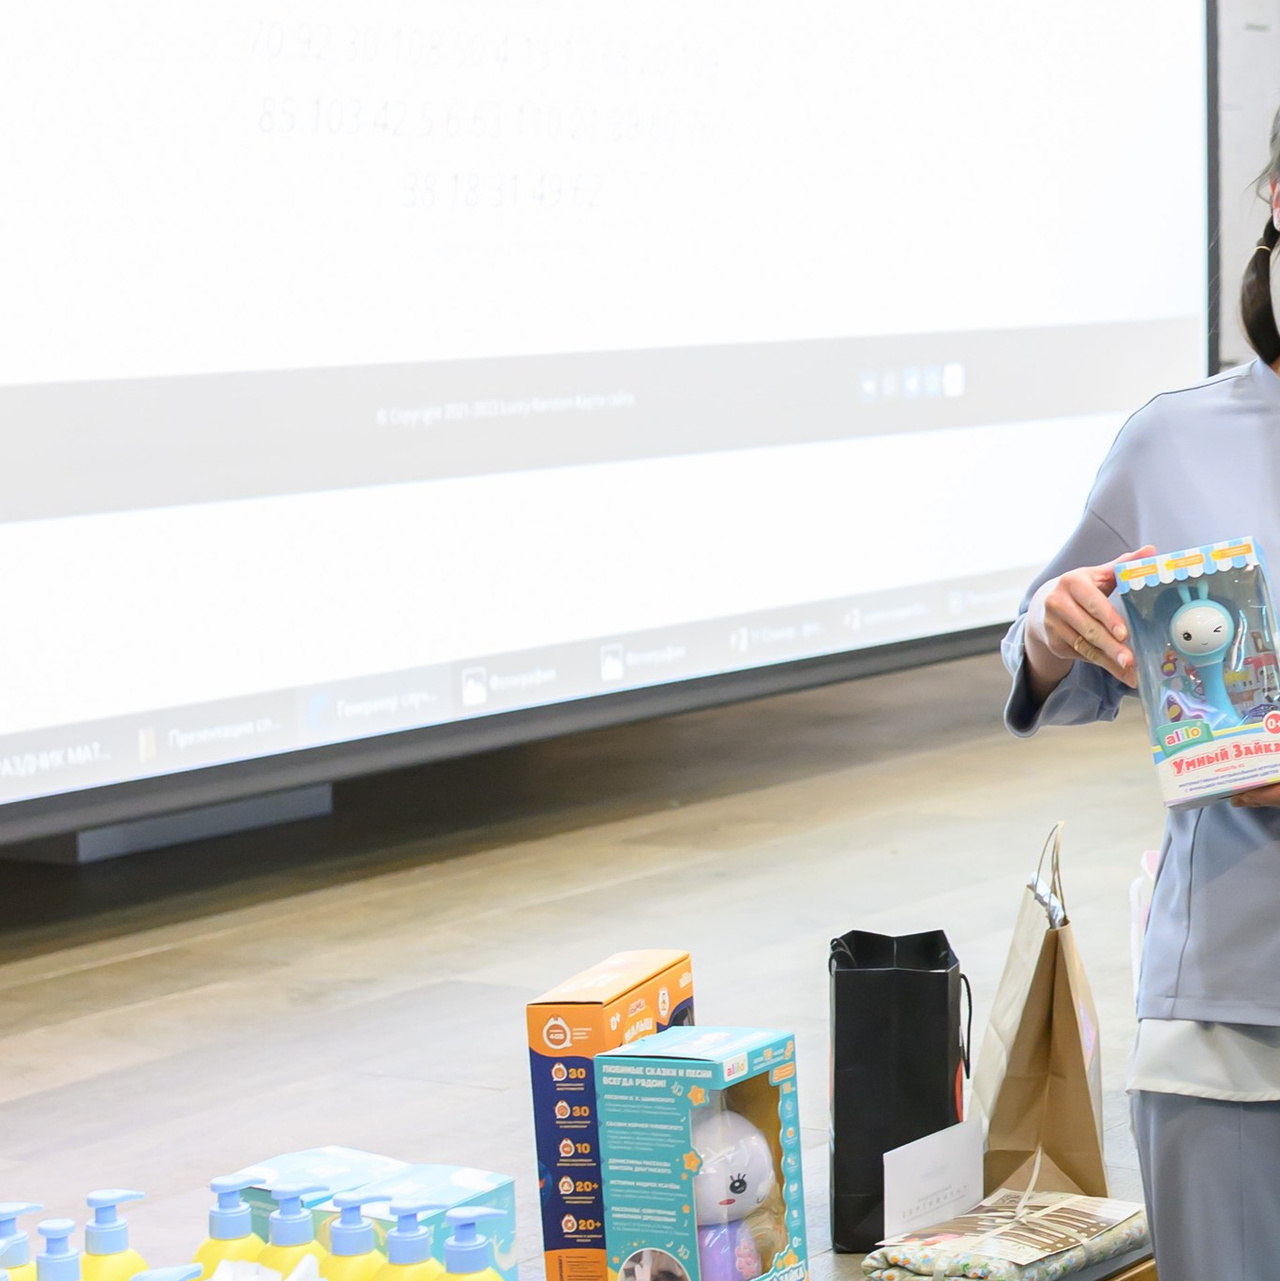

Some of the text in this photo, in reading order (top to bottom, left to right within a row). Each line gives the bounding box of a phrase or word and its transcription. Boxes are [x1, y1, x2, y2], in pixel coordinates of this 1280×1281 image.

[258, 96, 295, 134] 85
[313, 96, 363, 135] 103
[373, 99, 408, 136] 42
[1165, 725, 1202, 746] alilo
[568, 1068, 586, 1080] 30
[572, 1105, 590, 1117] 30
[575, 1142, 591, 1154] 10
[575, 1180, 599, 1192] 20+
[578, 1218, 602, 1231] 20+
